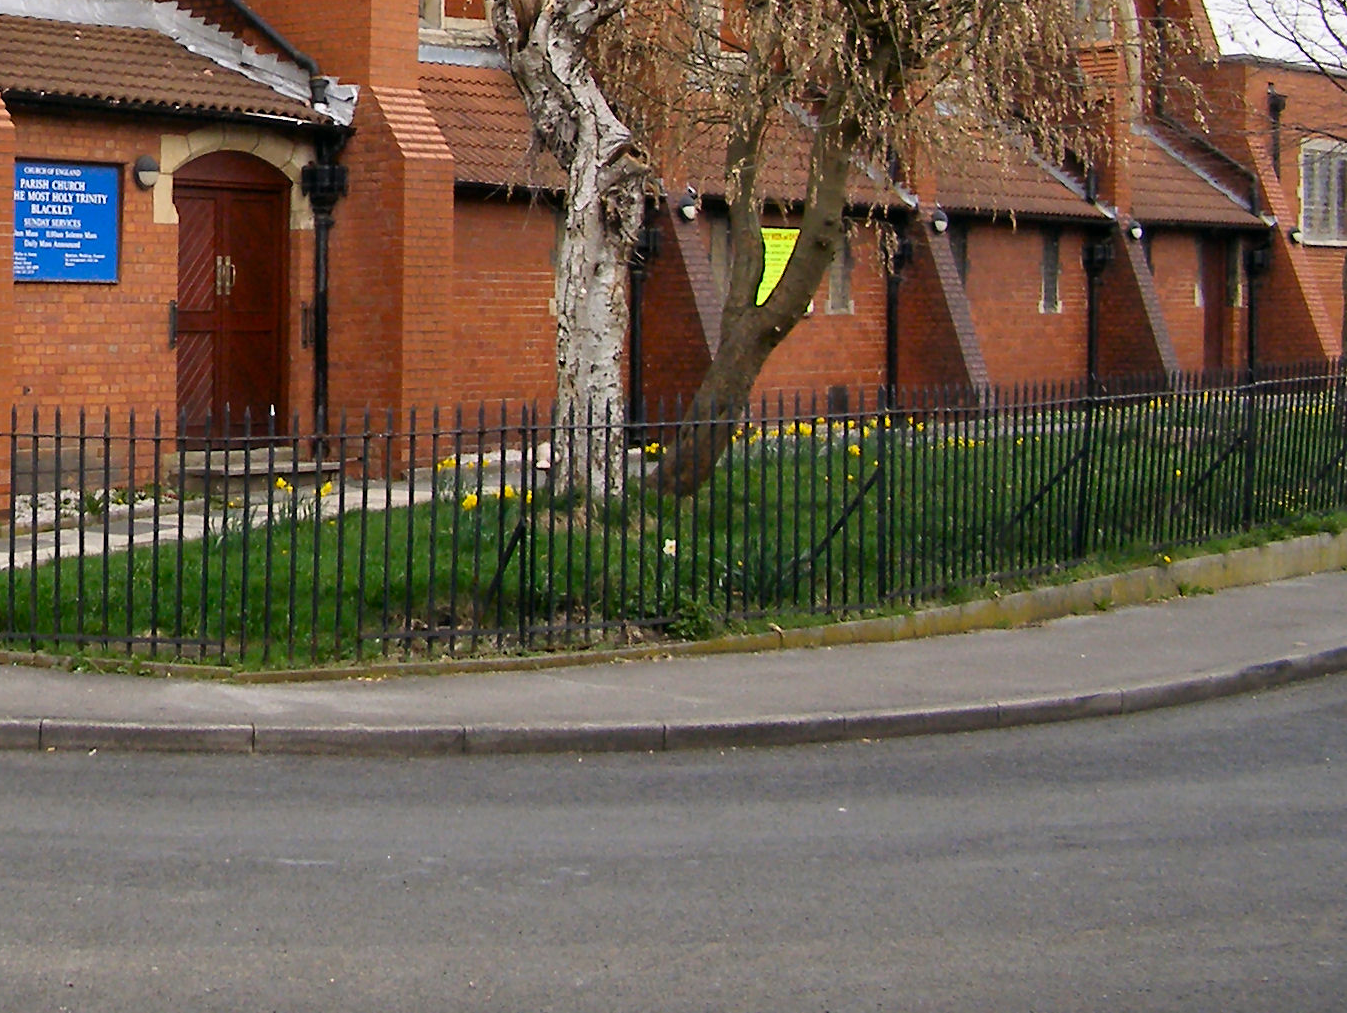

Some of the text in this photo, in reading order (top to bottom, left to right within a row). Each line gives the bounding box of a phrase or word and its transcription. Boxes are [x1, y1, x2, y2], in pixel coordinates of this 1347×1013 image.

[55, 168, 82, 177] ENGLAND
[20, 178, 86, 191] PARISH CHURCH
[14, 190, 108, 204] HE MOST HOLY TRINITY
[31, 204, 73, 215] BLACKLEY
[23, 218, 82, 228] SUNDAY SERVICES
